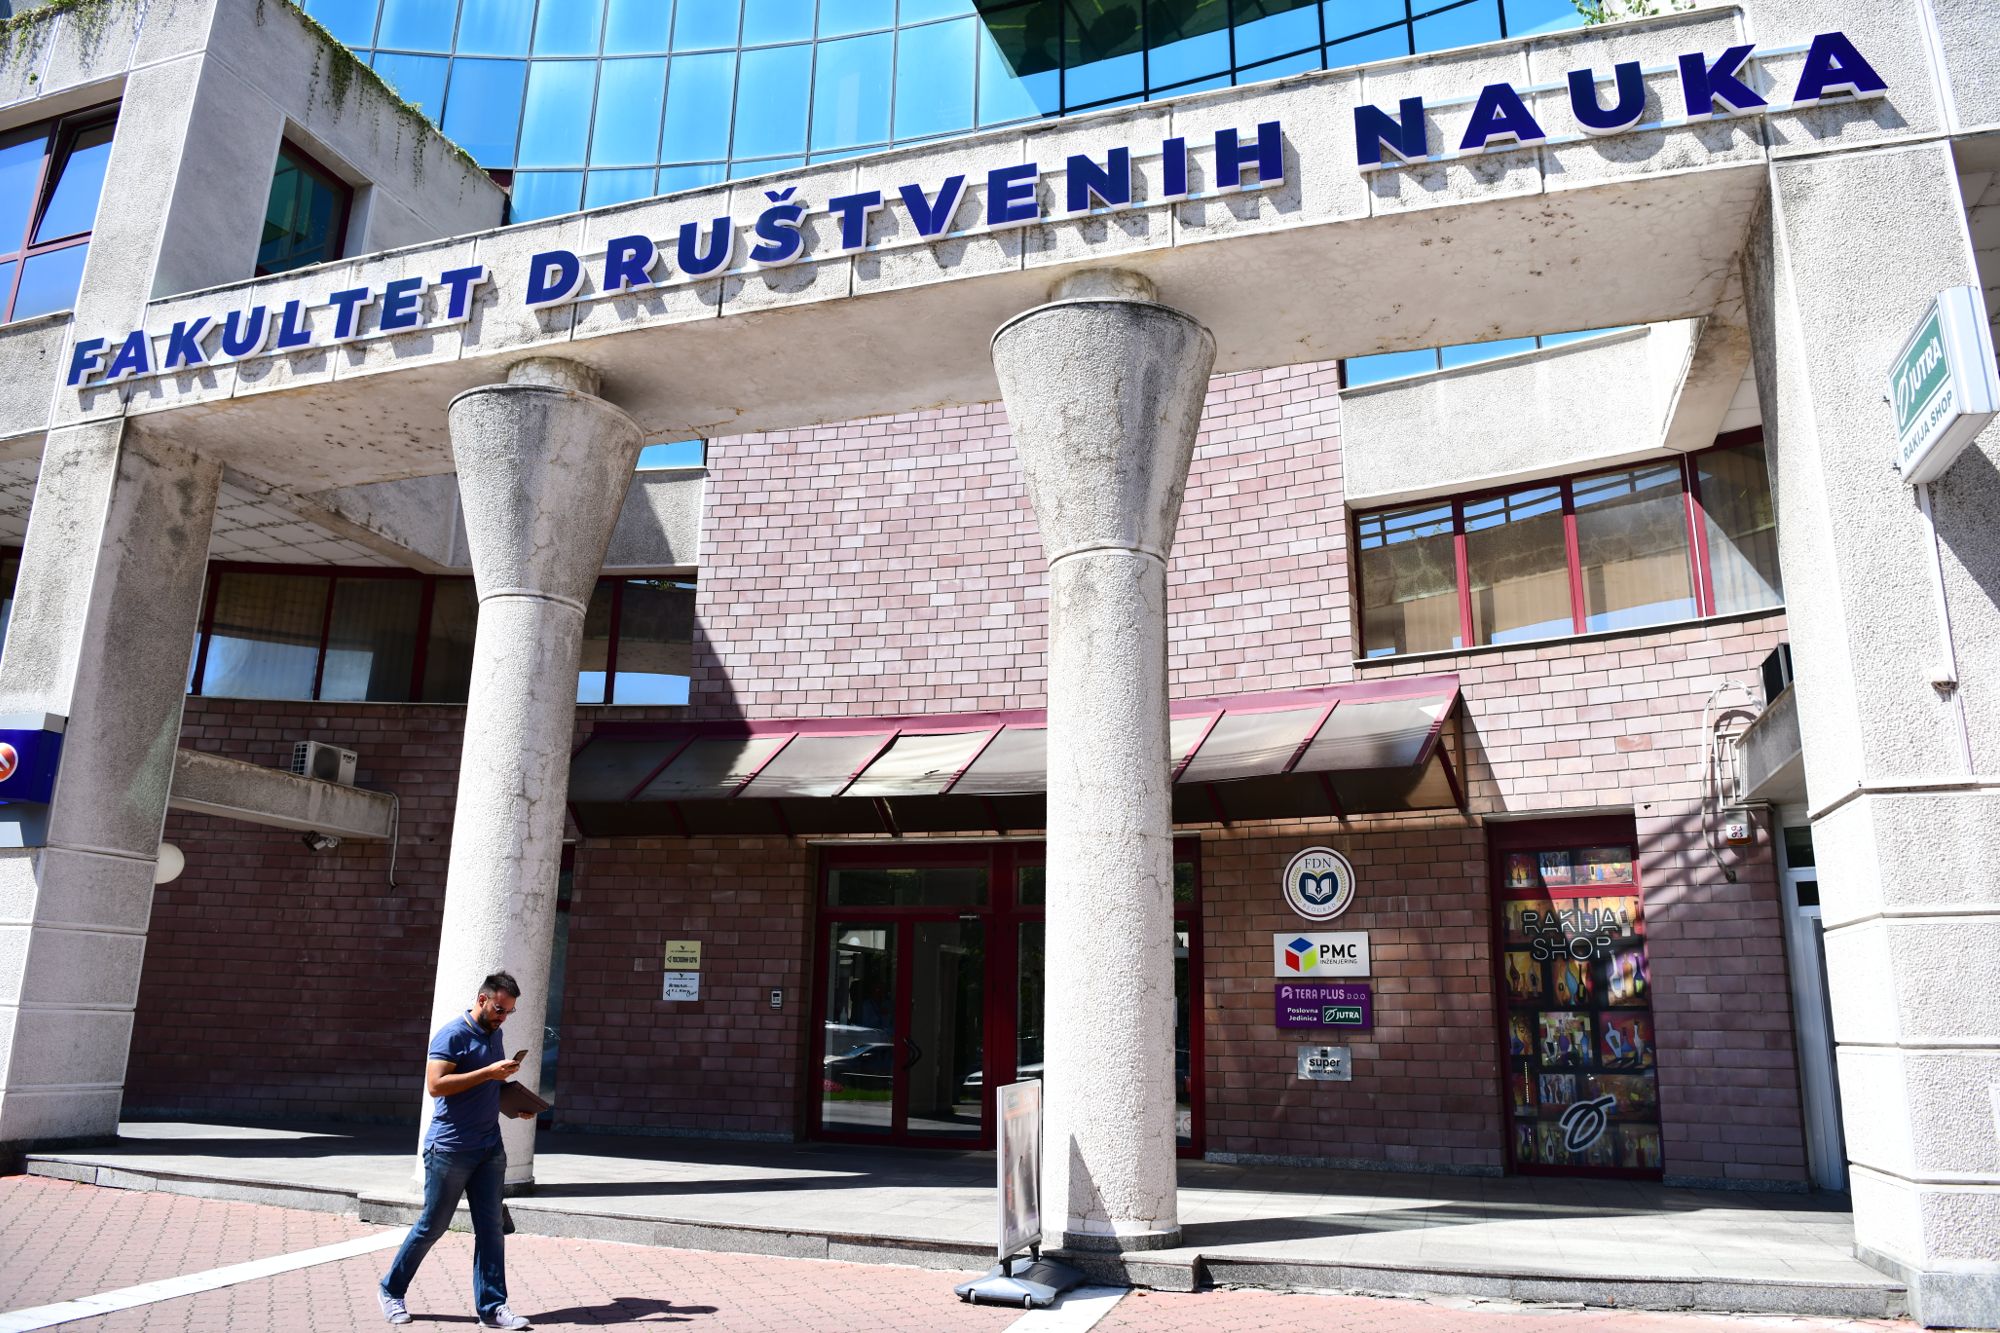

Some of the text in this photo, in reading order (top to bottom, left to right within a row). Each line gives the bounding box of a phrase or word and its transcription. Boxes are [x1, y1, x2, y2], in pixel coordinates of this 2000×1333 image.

[67, 31, 1888, 388] FAKULTET DRUŠTVENIH NAUKA
[1903, 389, 1953, 463] RAKIJA SHOP
[1304, 857, 1332, 869] FDN
[1522, 908, 1619, 935] RAKIJA
[1320, 943, 1357, 958] PMC
[1532, 936, 1613, 961] SHOP
[1295, 988, 1318, 1000] TERA
[1320, 988, 1345, 1000] PLUS
[1336, 1011, 1360, 1020] JUTRA
[1309, 1058, 1341, 1069] super
